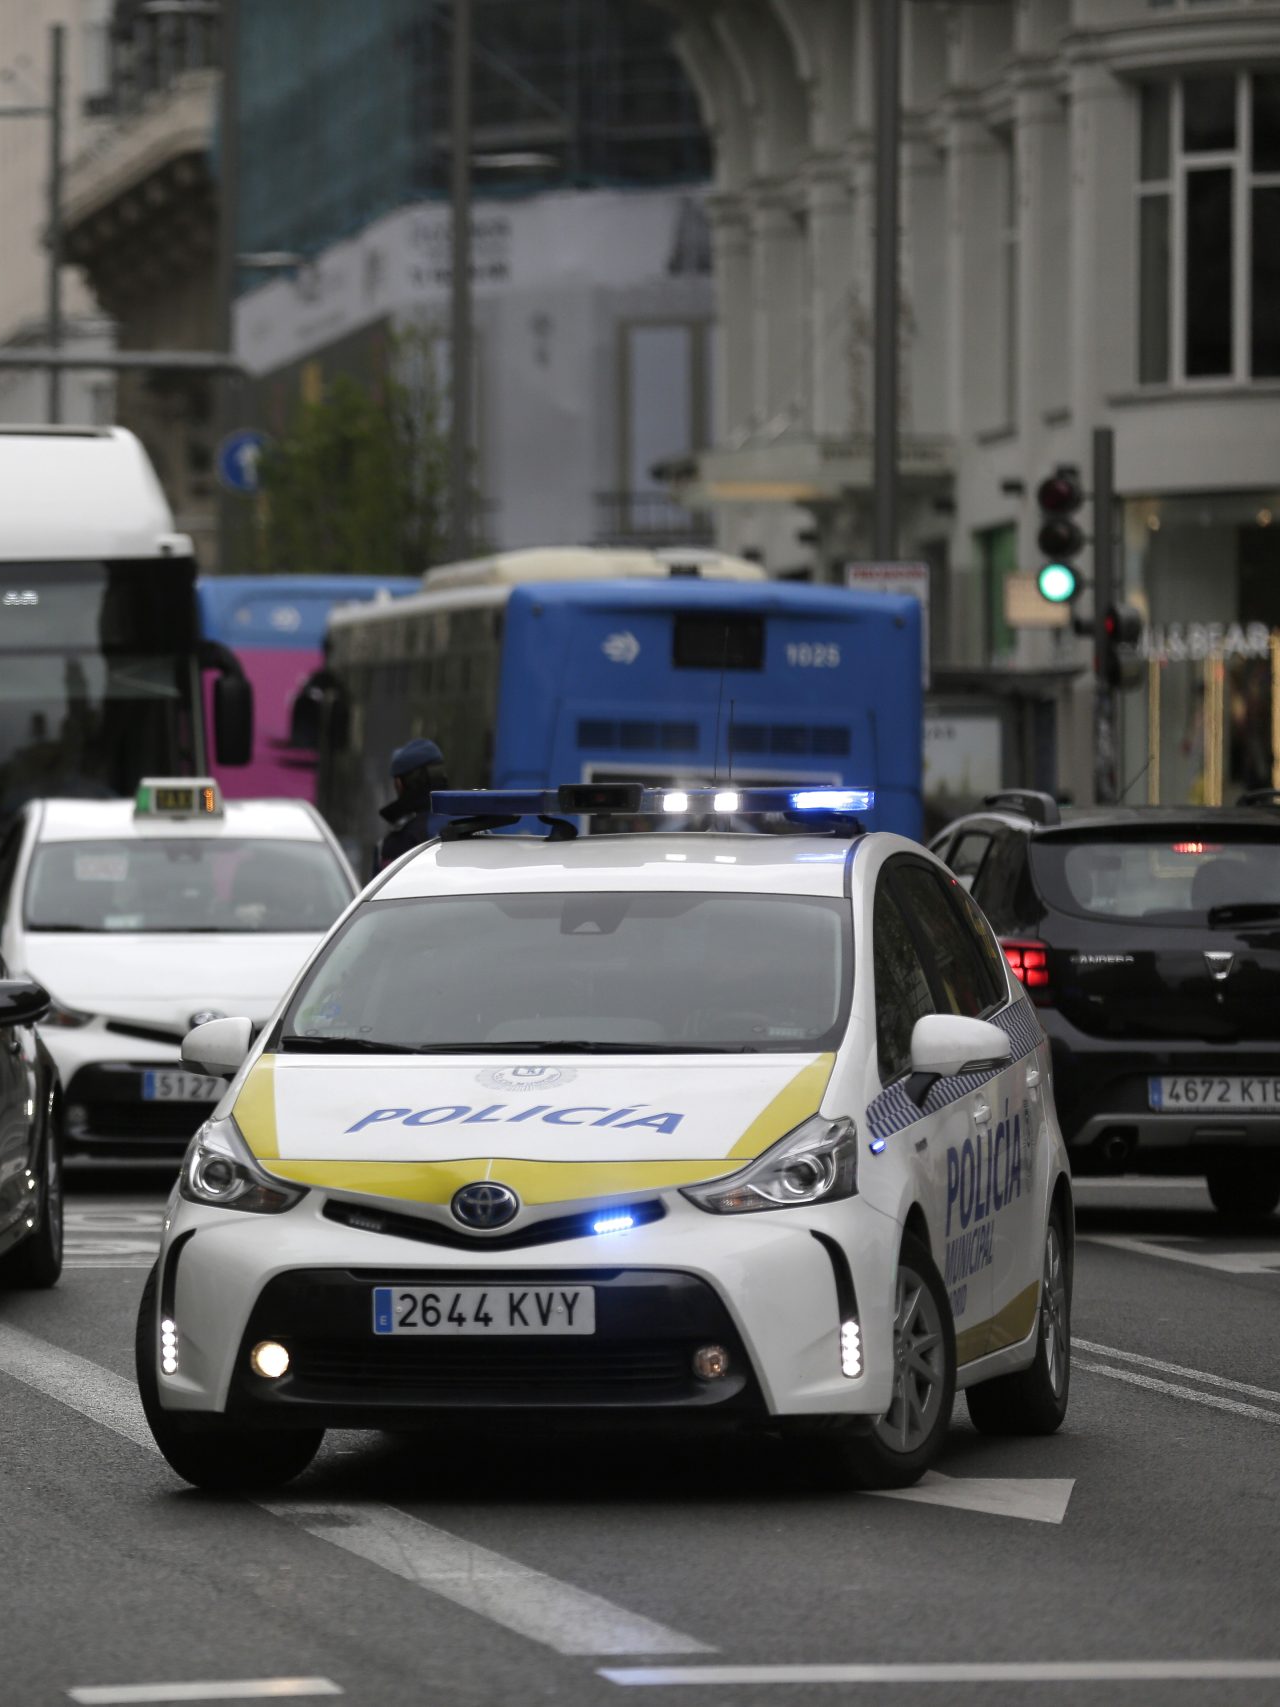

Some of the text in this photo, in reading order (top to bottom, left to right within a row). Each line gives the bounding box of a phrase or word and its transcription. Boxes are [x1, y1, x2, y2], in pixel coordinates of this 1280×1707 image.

[1168, 1078, 1231, 1103] 4672
[343, 1103, 689, 1135] POLICÍA
[945, 1097, 1021, 1238] POLICÍA
[398, 1291, 580, 1328] 2644 KVY
